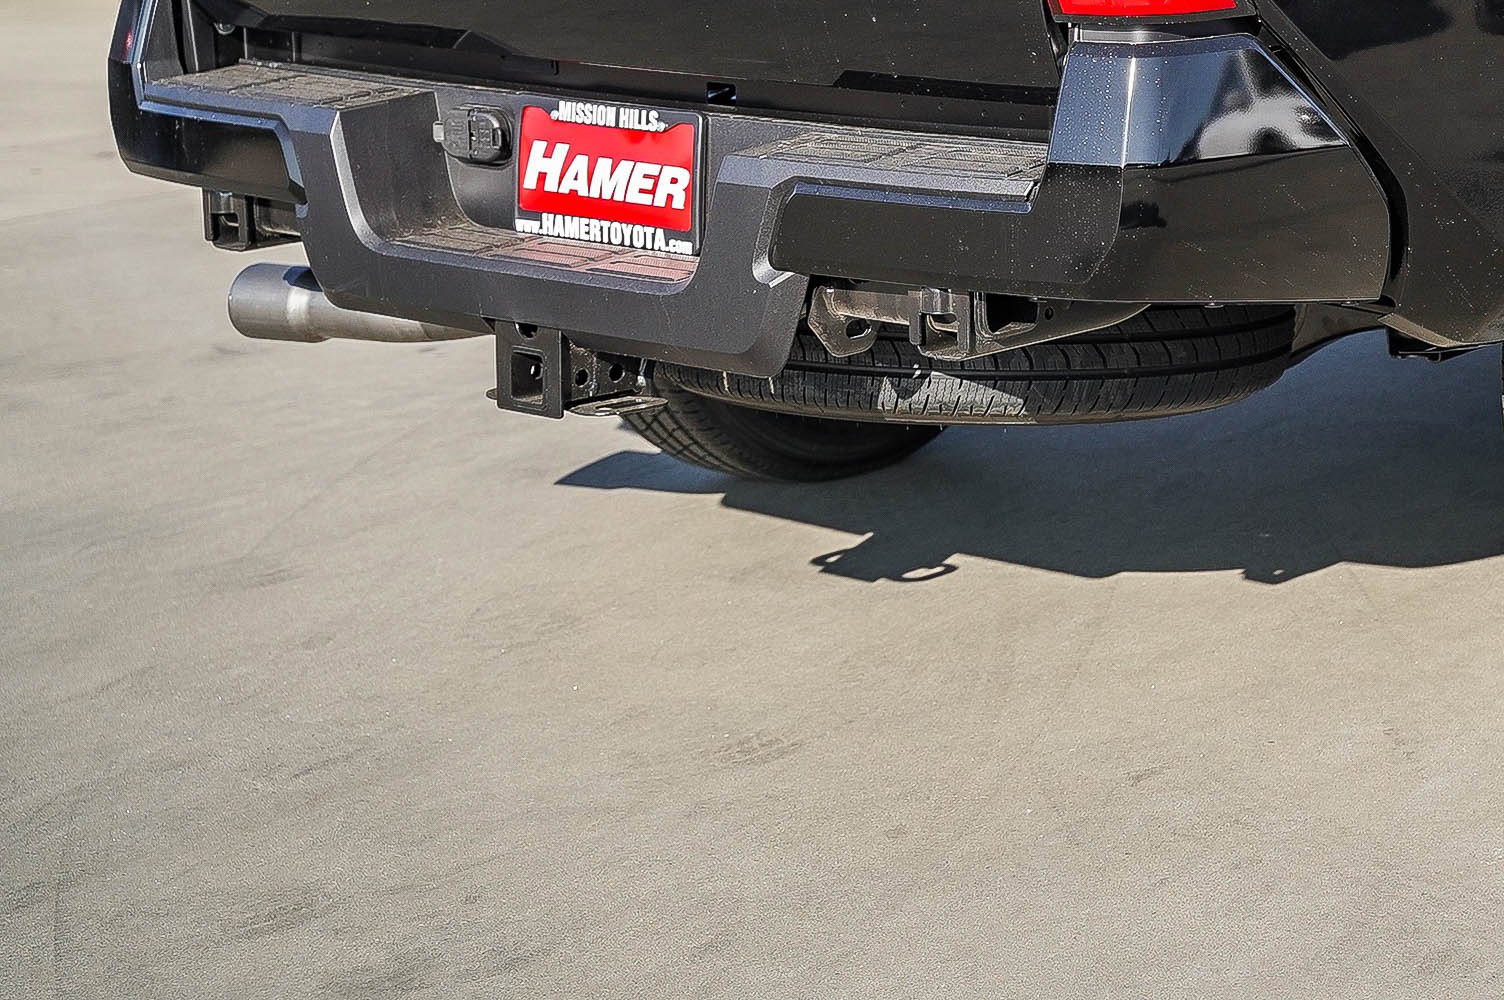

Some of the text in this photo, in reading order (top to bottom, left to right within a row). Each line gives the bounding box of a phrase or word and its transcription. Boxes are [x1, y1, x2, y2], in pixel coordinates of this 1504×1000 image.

[558, 101, 660, 132] MISSION HILLS
[523, 139, 691, 210] HAMER
[515, 213, 692, 255] www.HAMERTOYOTA.com
